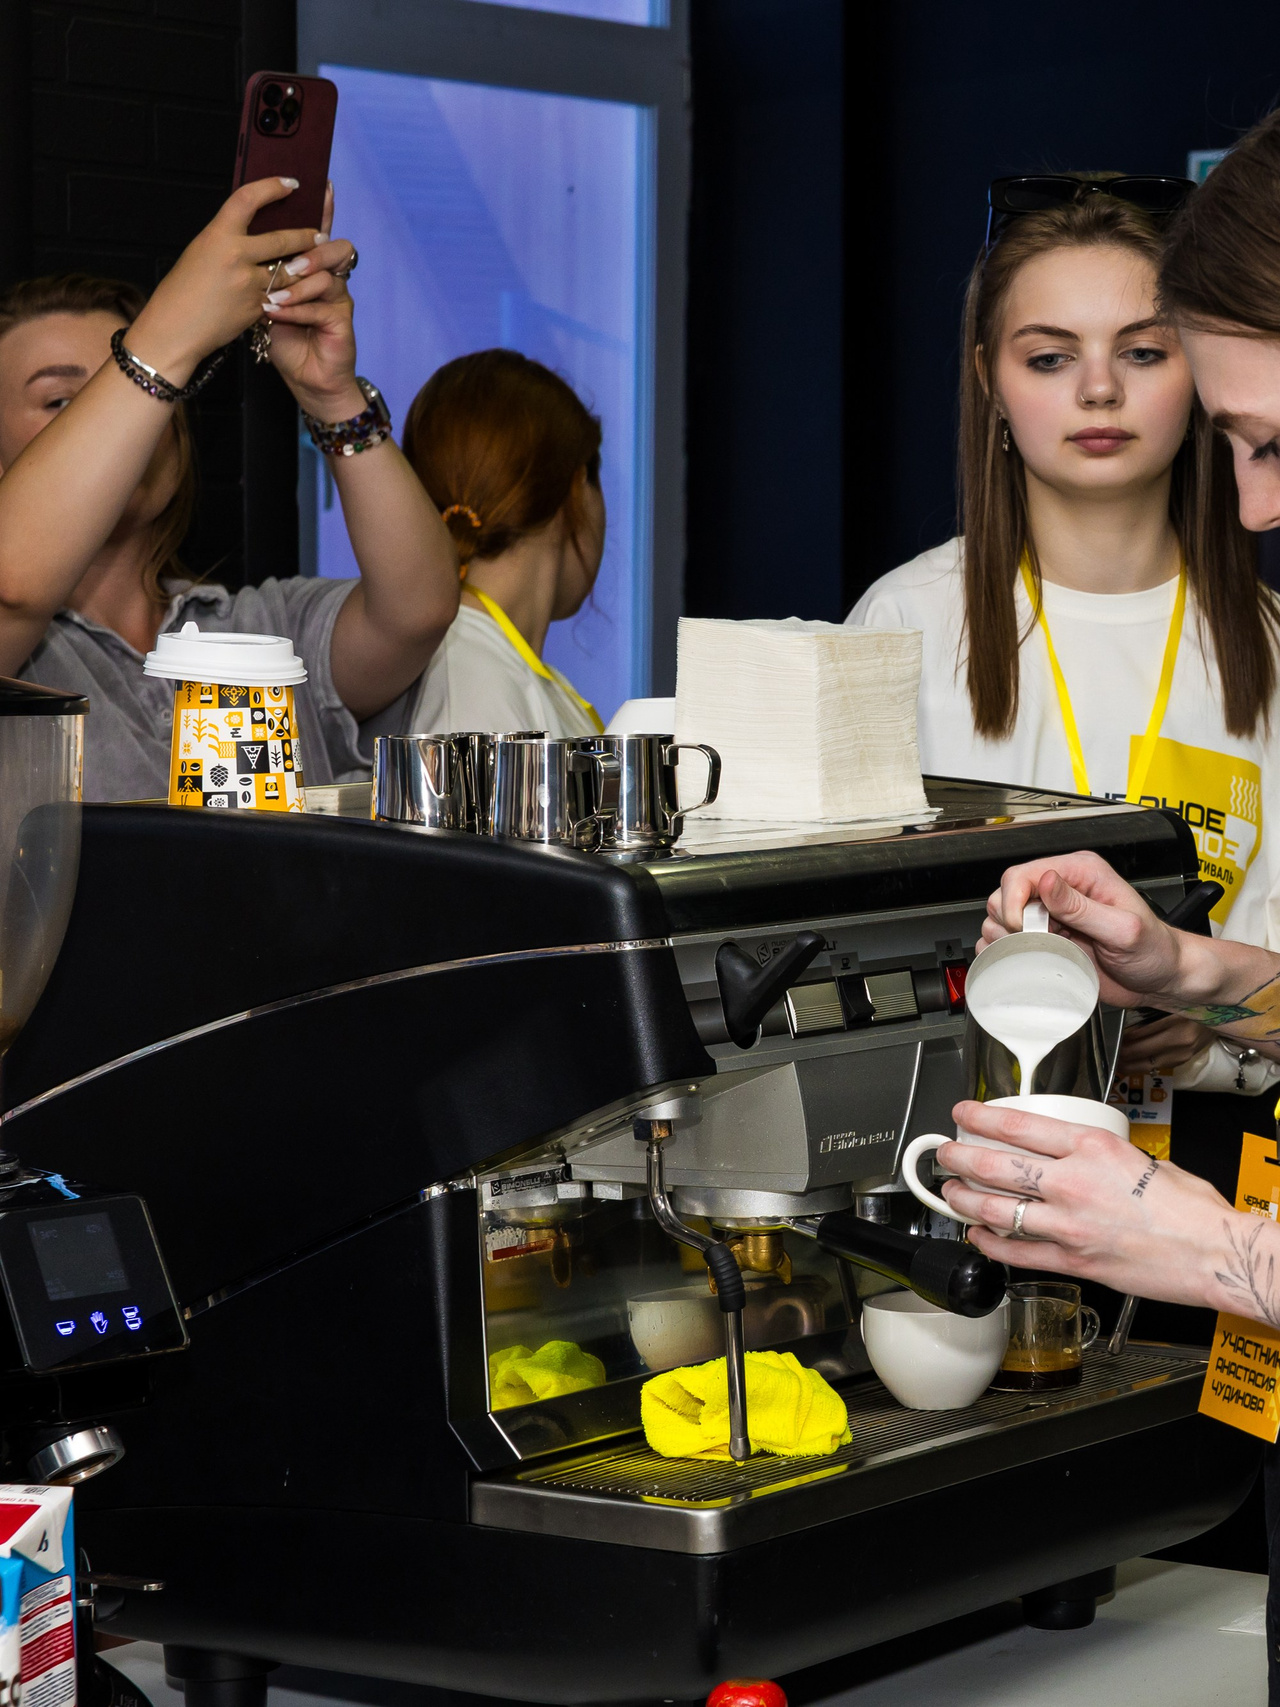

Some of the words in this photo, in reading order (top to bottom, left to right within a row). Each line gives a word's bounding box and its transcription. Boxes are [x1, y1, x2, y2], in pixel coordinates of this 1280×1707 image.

[1198, 858, 1235, 885] ТИВАЛЬ
[1131, 1160, 1160, 1198] RTUNE
[1215, 1356, 1277, 1393] АНАСТАСИЯ
[1211, 1379, 1265, 1414] ЧУДИНОВА
